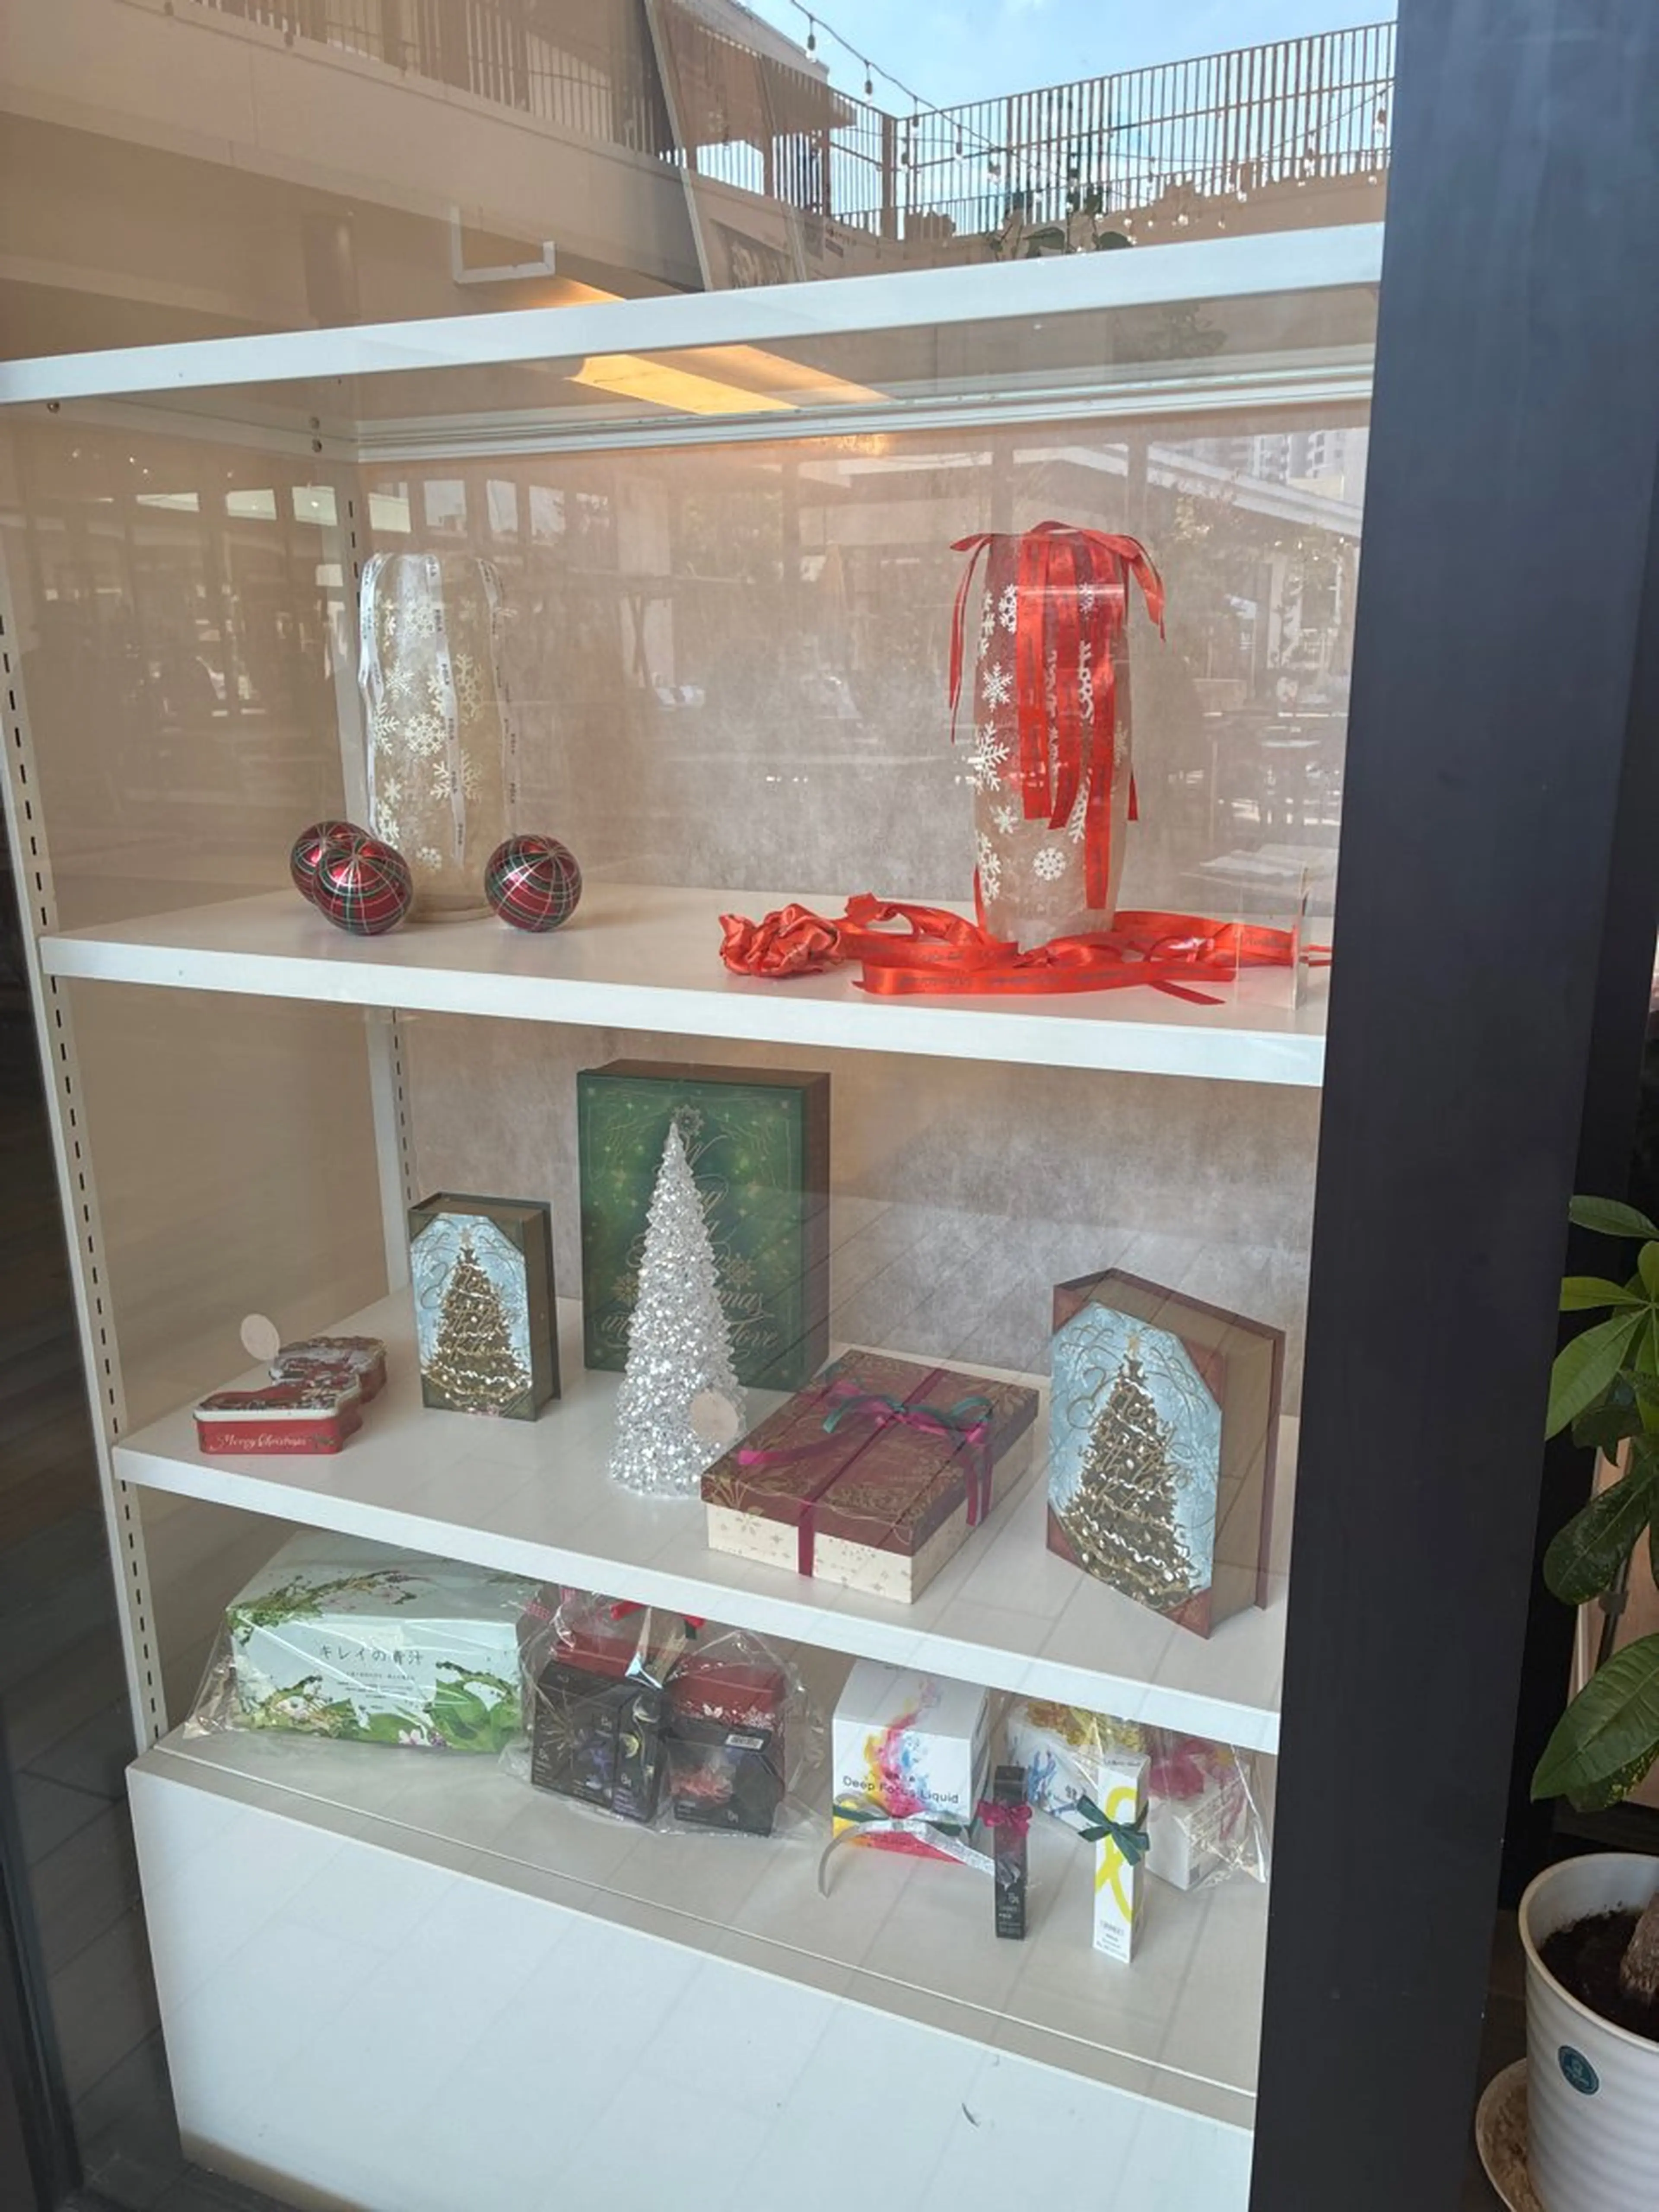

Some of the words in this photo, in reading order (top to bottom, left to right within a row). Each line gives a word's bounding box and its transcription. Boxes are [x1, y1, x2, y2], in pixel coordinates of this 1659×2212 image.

[321, 1644, 423, 1665] キレイの青汁
[843, 1775, 875, 1792] Deep
[920, 1788, 960, 1804] Liquid
